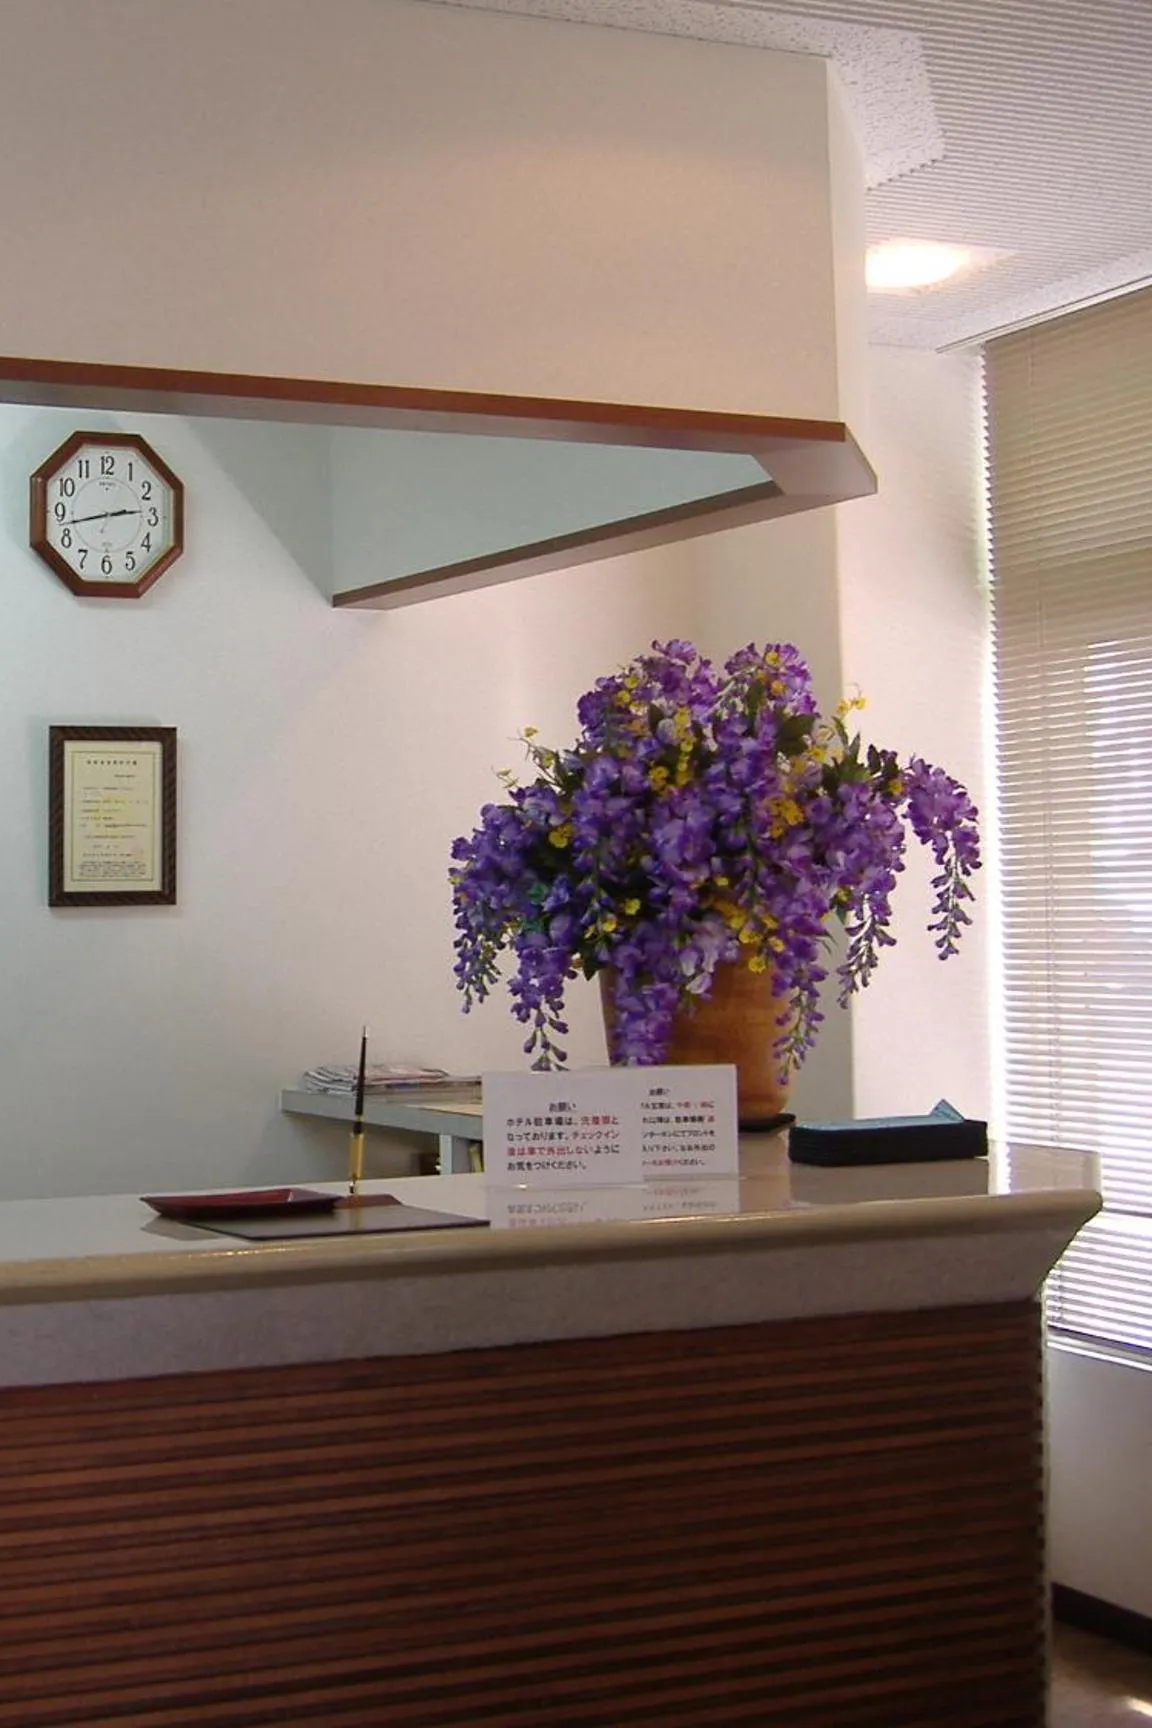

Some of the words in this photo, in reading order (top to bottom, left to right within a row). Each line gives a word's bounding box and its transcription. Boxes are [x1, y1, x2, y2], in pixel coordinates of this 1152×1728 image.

[78, 460, 90, 479] 11
[100, 455, 115, 476] 12
[128, 462, 133, 482] 1
[59, 477, 75, 497] 10
[141, 481, 152, 500] 2
[55, 502, 66, 522] 9
[148, 507, 159, 527] 3
[61, 528, 72, 549] 8
[141, 532, 152, 552] 4
[77, 549, 88, 569] 7
[101, 555, 113, 575] 6
[125, 551, 136, 571] 5
[549, 1102, 576, 1112] お願い
